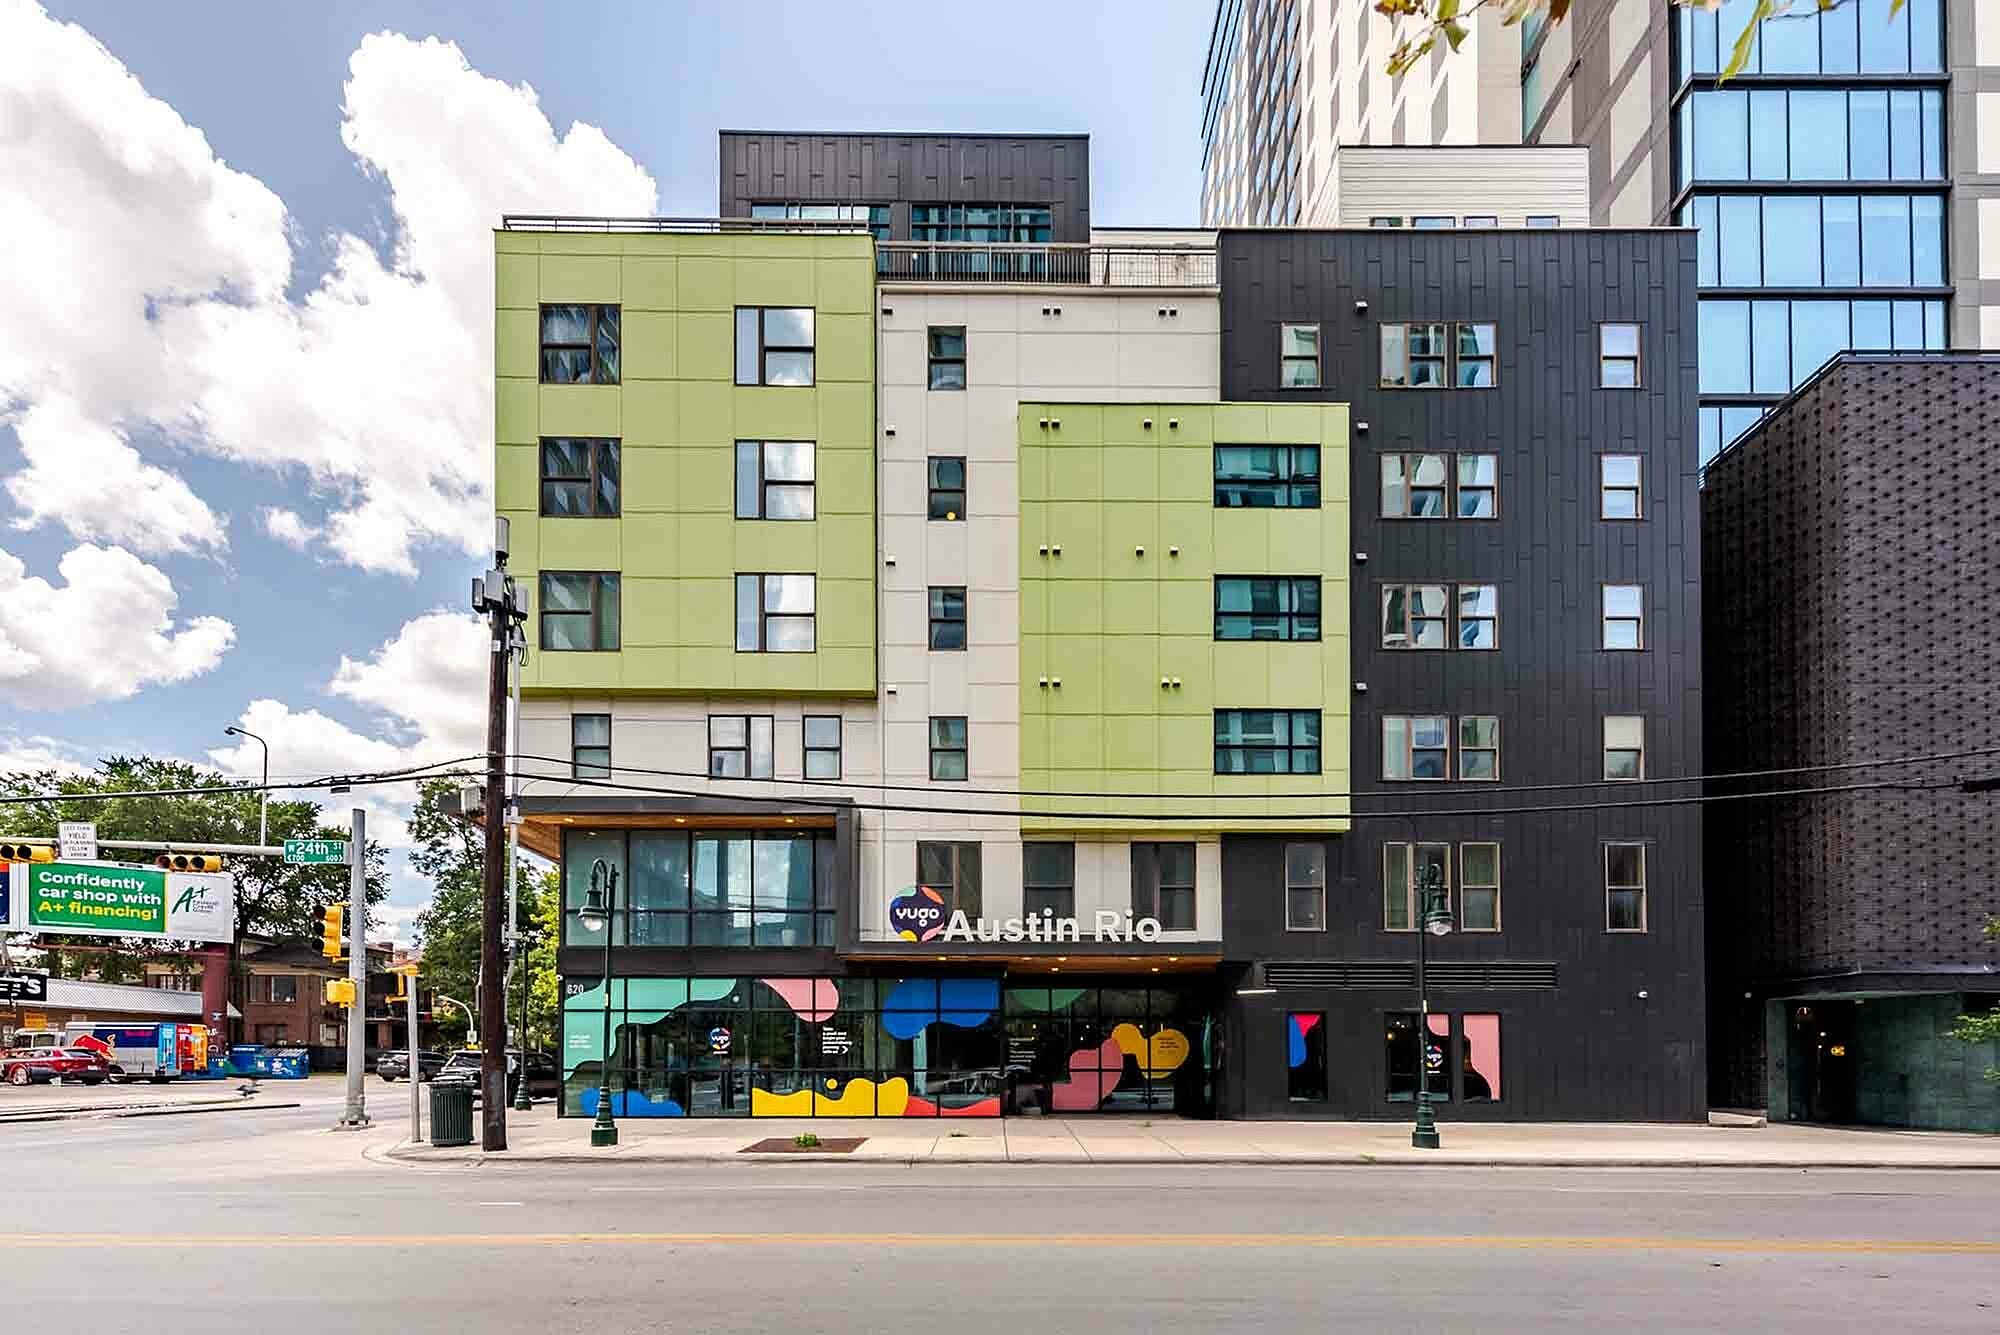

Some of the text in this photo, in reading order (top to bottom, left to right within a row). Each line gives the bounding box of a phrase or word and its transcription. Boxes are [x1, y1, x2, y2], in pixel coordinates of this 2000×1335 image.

[296, 842, 329, 855] 24th
[39, 871, 145, 891] Confidently
[39, 887, 161, 905] car shop with
[38, 901, 158, 921] A+ financing!
[895, 907, 940, 928] yugo
[944, 907, 1162, 942] Austin Rio
